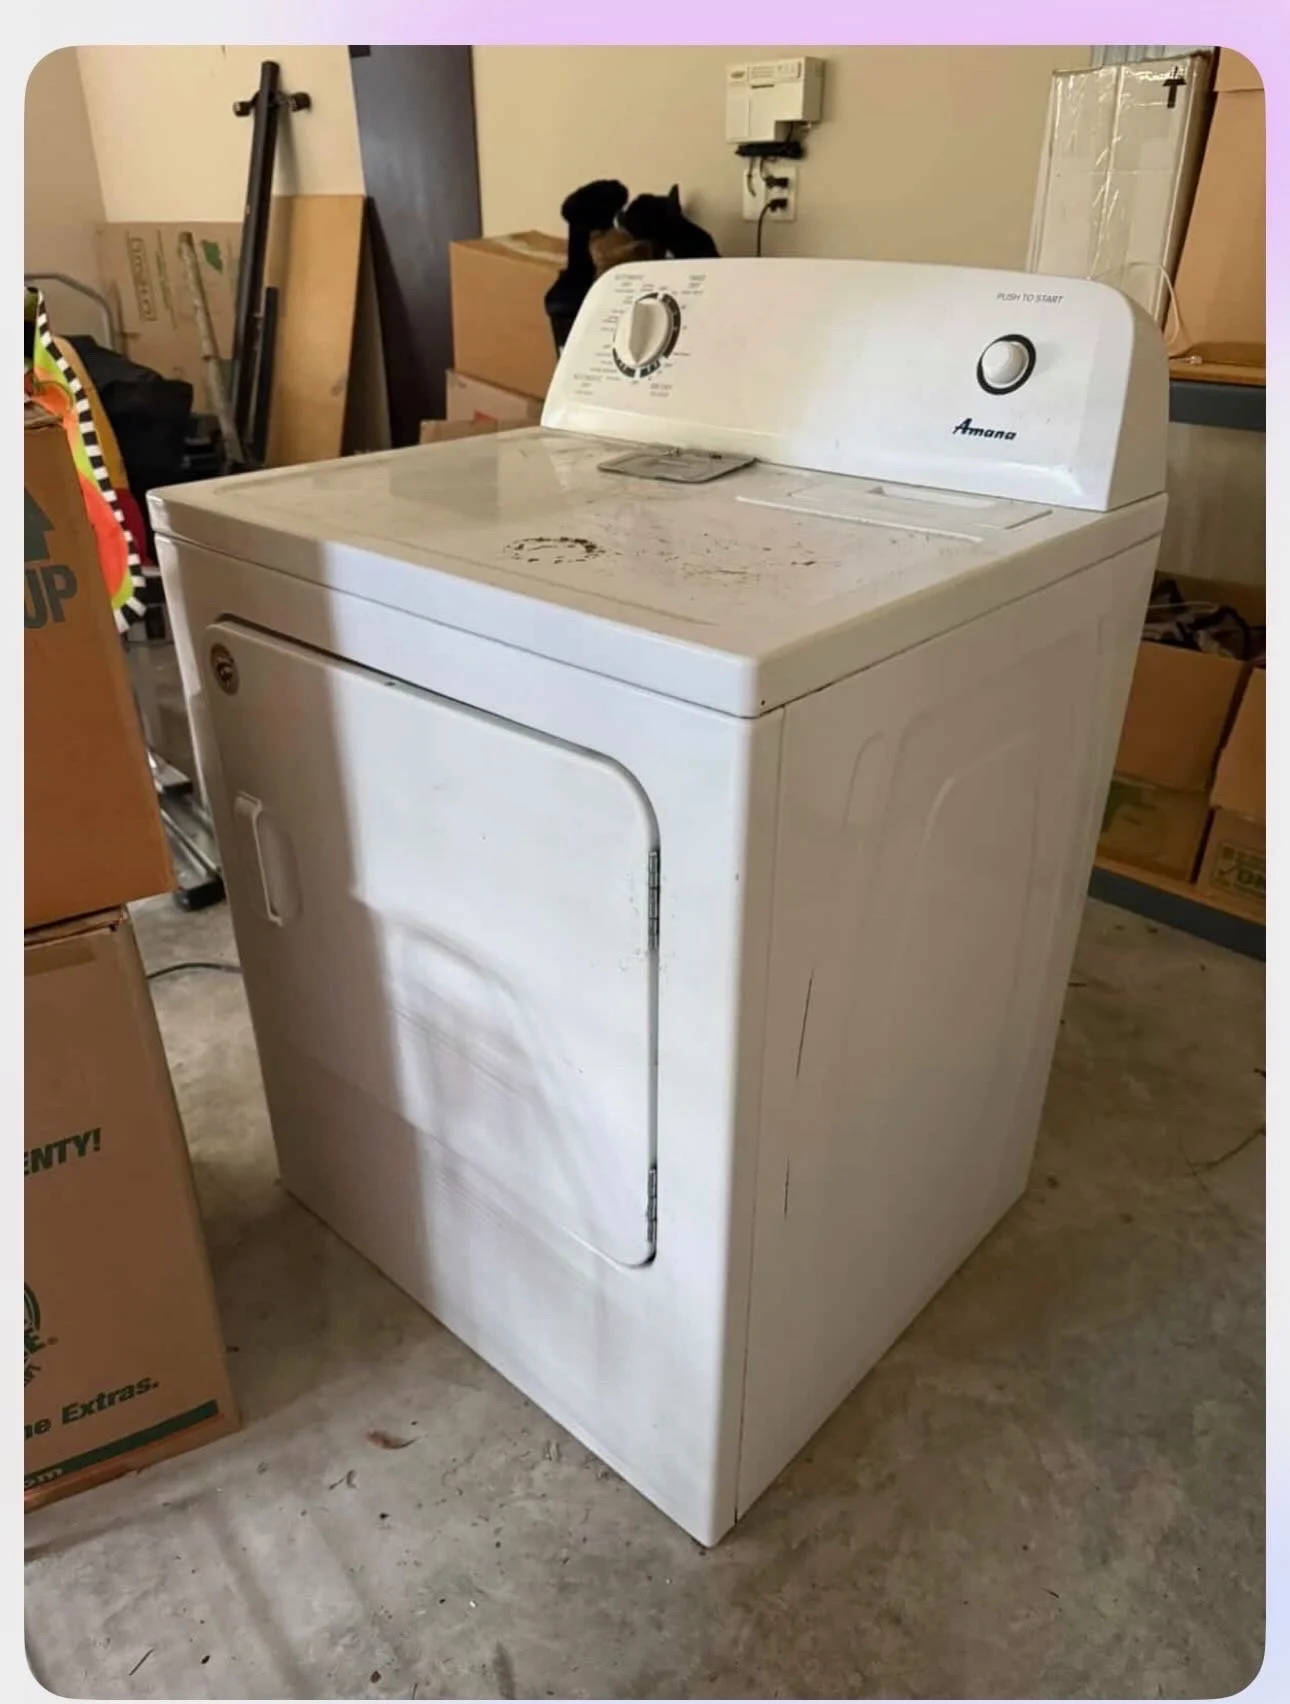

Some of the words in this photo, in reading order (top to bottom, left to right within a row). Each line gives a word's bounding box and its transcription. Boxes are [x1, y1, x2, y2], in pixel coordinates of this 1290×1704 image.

[996, 292, 1020, 301] PUSH
[1022, 293, 1035, 302] TO
[1036, 294, 1064, 304] START
[952, 417, 1017, 441] Amana
[24, 565, 78, 629] UP
[62, 1376, 159, 1425] Extras.
